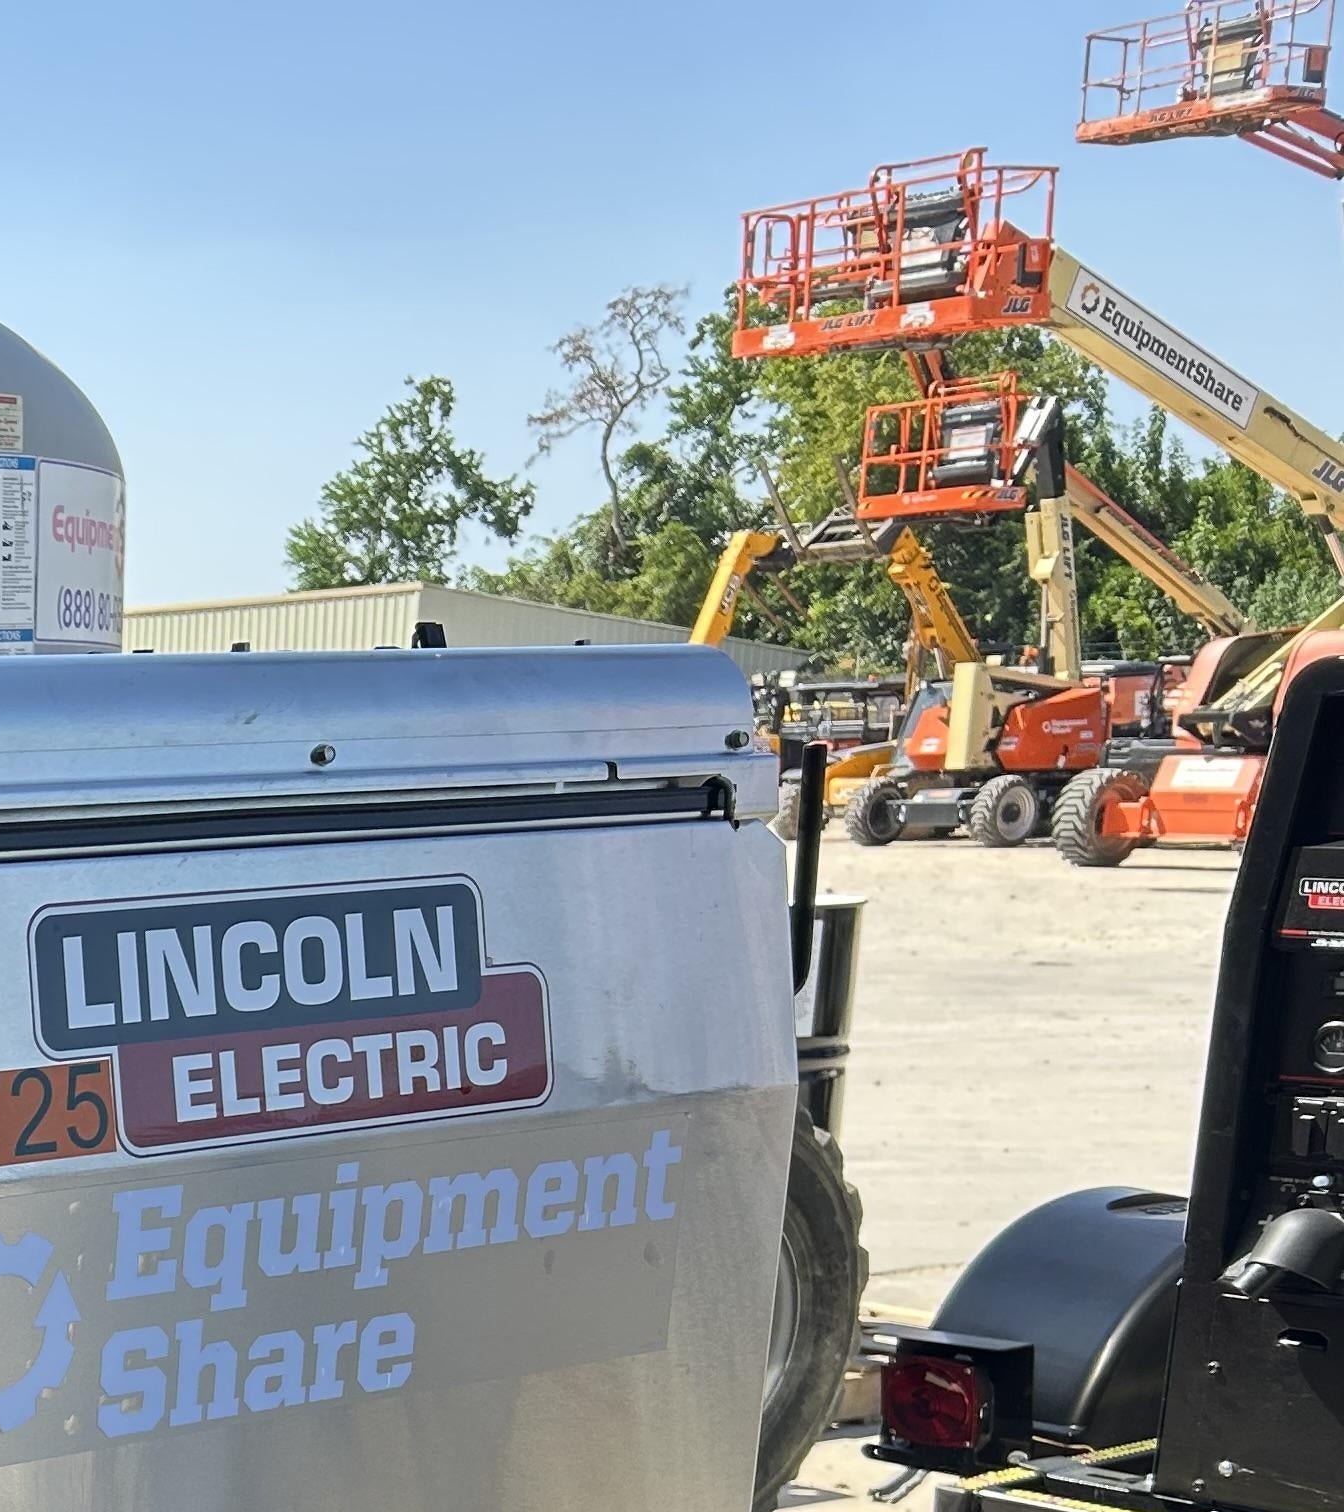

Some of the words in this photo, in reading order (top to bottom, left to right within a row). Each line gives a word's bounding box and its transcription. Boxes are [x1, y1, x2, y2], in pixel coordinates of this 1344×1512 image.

[822, 319, 843, 331] JLG
[846, 314, 875, 327] LIFT
[1002, 296, 1032, 315] JLG
[1098, 295, 1246, 414] EquipmentShare
[1312, 460, 1344, 493] JLG
[57, 585, 96, 632] (888)
[62, 904, 459, 1030] LINCOLN
[171, 1021, 508, 1123] ELECTRIC
[106, 1129, 683, 1312] Equipment
[96, 1311, 415, 1438] Share
